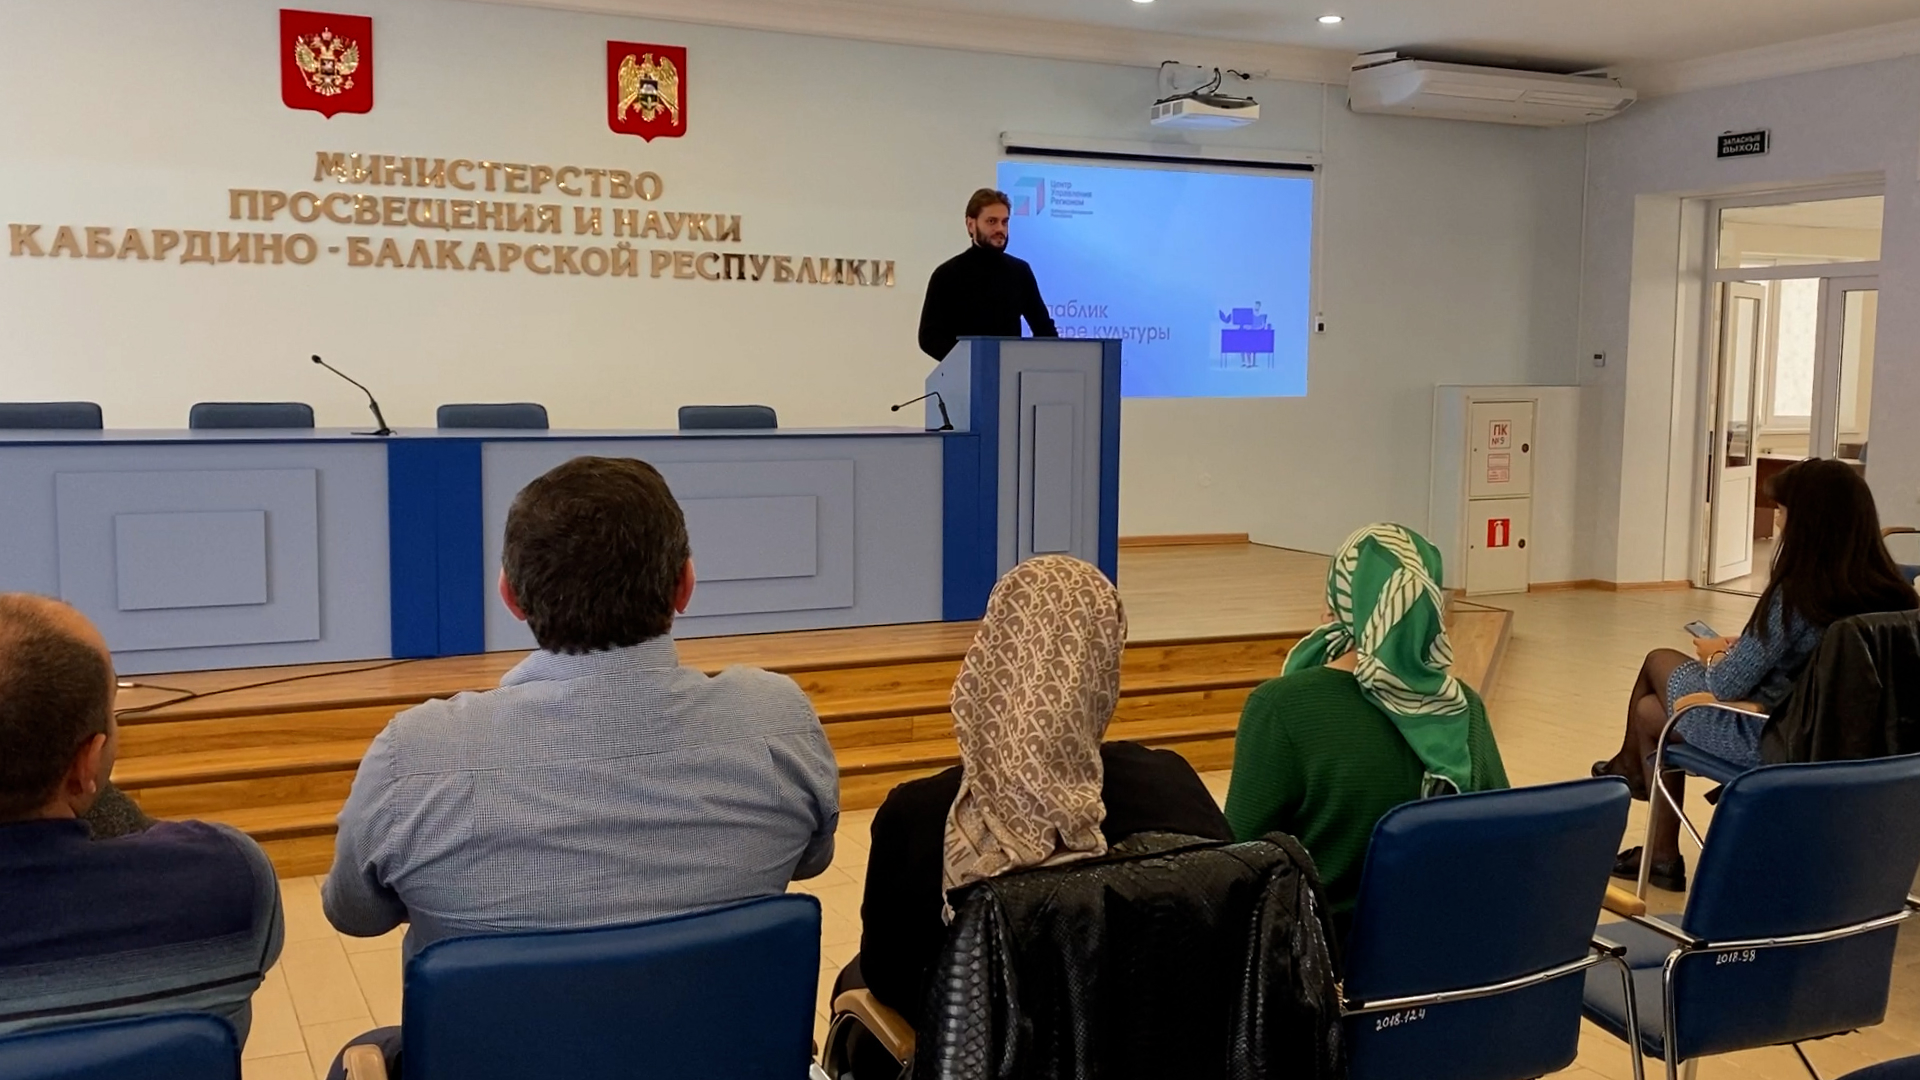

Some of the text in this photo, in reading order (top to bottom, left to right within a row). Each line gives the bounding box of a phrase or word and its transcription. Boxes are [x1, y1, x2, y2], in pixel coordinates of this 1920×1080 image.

[1722, 142, 1760, 154] ВЫХОД
[313, 151, 664, 201] МИНИСТЕРСТВО
[228, 188, 742, 242] ПРОСВЕЩЕНИЯ И НАУКИ
[650, 249, 896, 286] РЕСПУБЛИКИ
[1094, 325, 1170, 344] культуры
[1493, 423, 1508, 436] ПК
